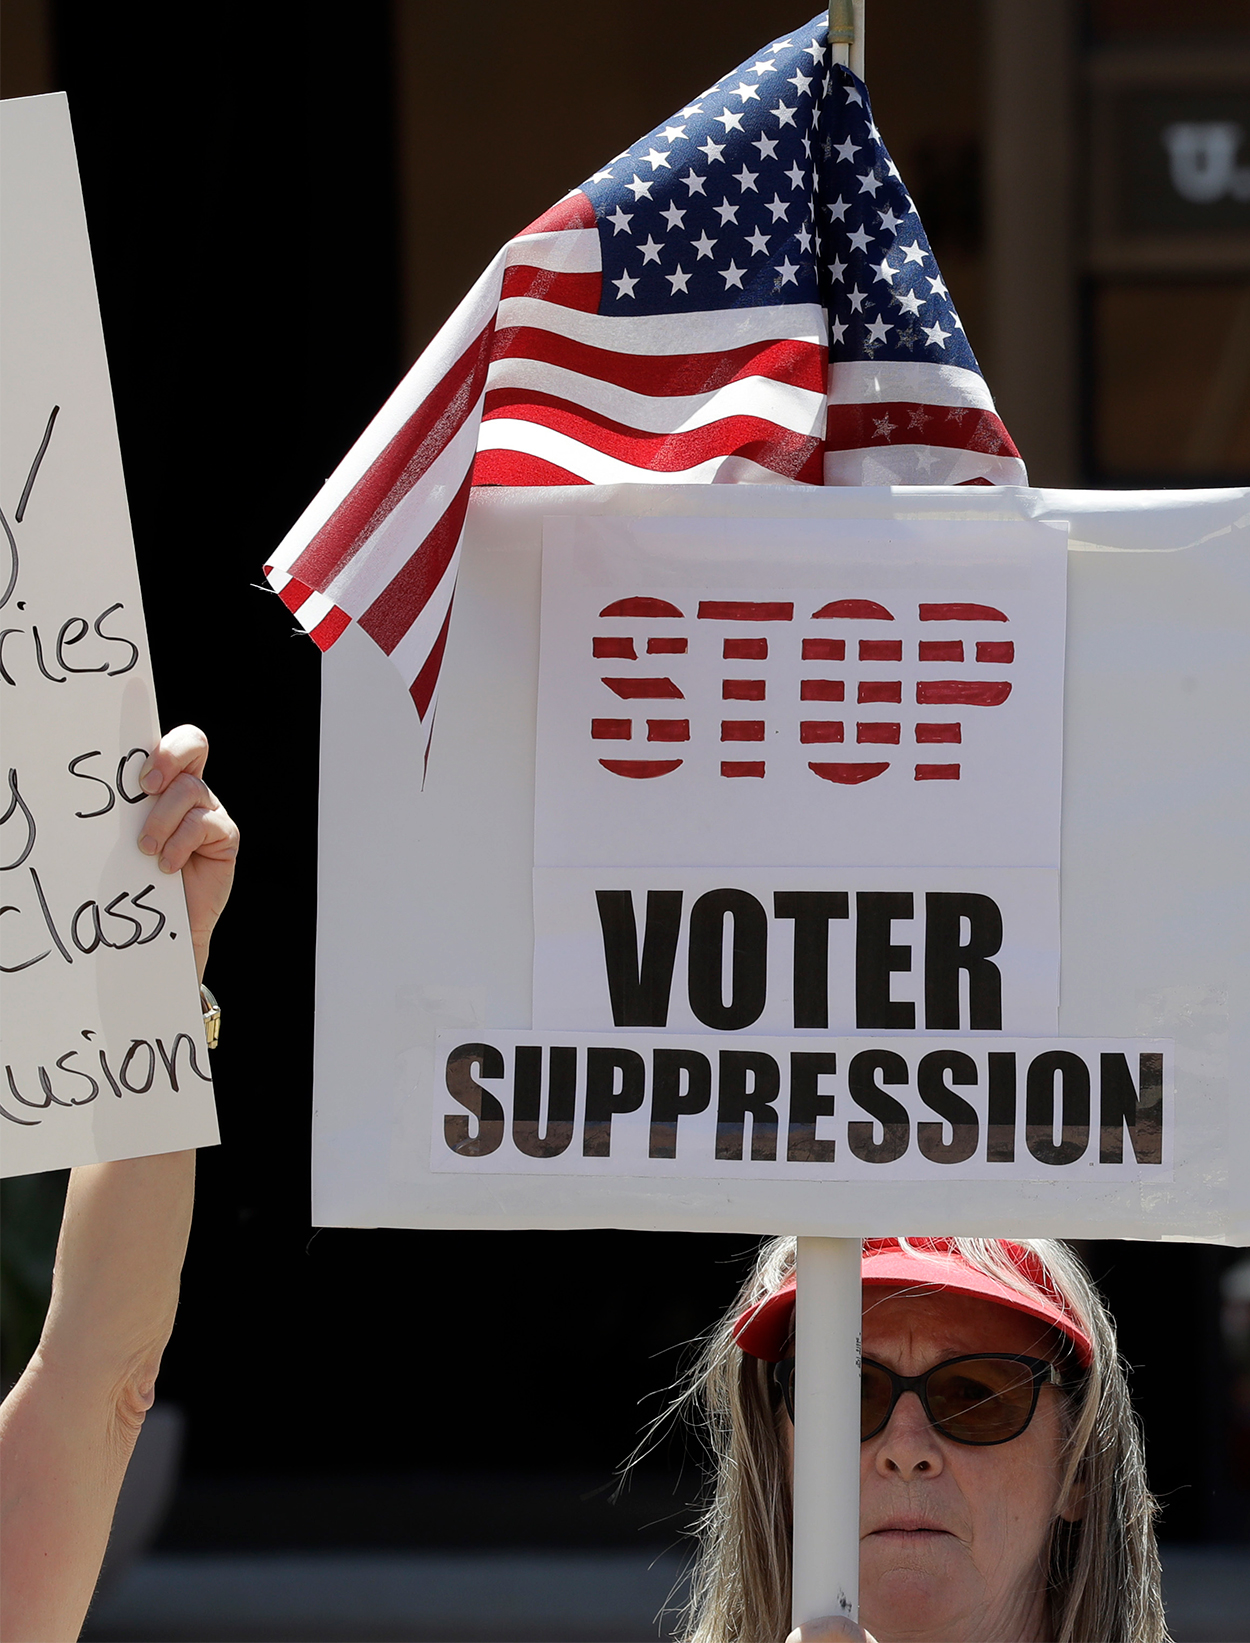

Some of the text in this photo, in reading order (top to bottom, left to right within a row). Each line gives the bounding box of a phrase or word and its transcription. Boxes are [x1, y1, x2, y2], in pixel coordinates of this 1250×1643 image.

[591, 596, 1015, 785] STOP
[594, 888, 1004, 1031] VOTER
[443, 1042, 1164, 1166] SUPPRESSION
